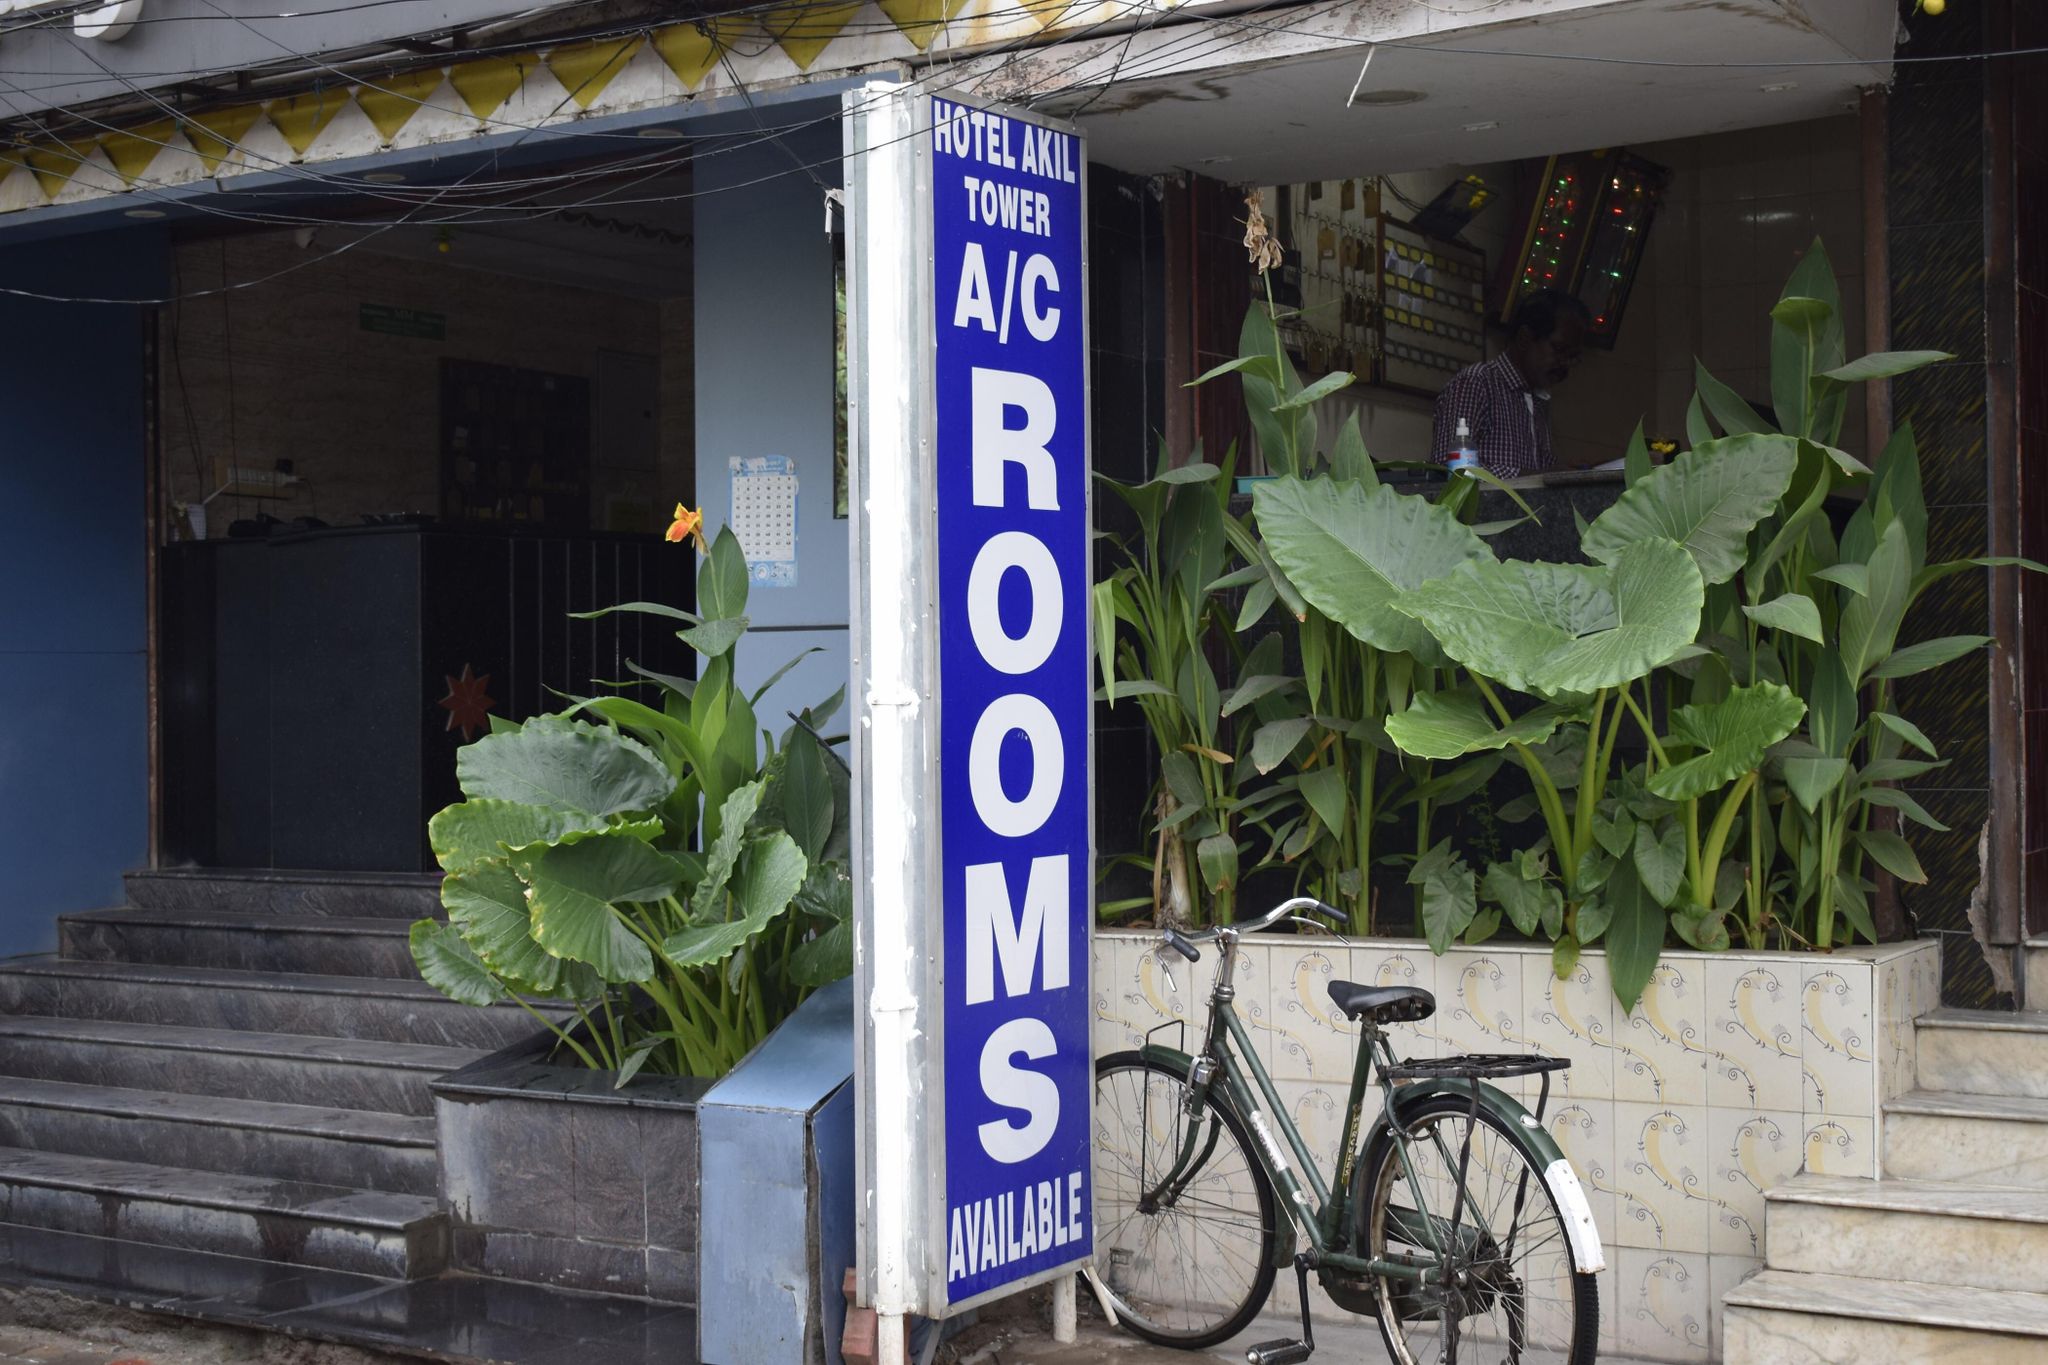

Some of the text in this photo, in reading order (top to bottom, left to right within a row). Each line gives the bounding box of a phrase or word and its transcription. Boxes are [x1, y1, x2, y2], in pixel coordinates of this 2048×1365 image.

[934, 101, 1075, 184] HOTEL AKIL
[964, 175, 1051, 237] TOWER
[953, 241, 1061, 344] A/C
[966, 366, 1070, 1165] ROOMS
[948, 1171, 1083, 1283] AVAILABLE
